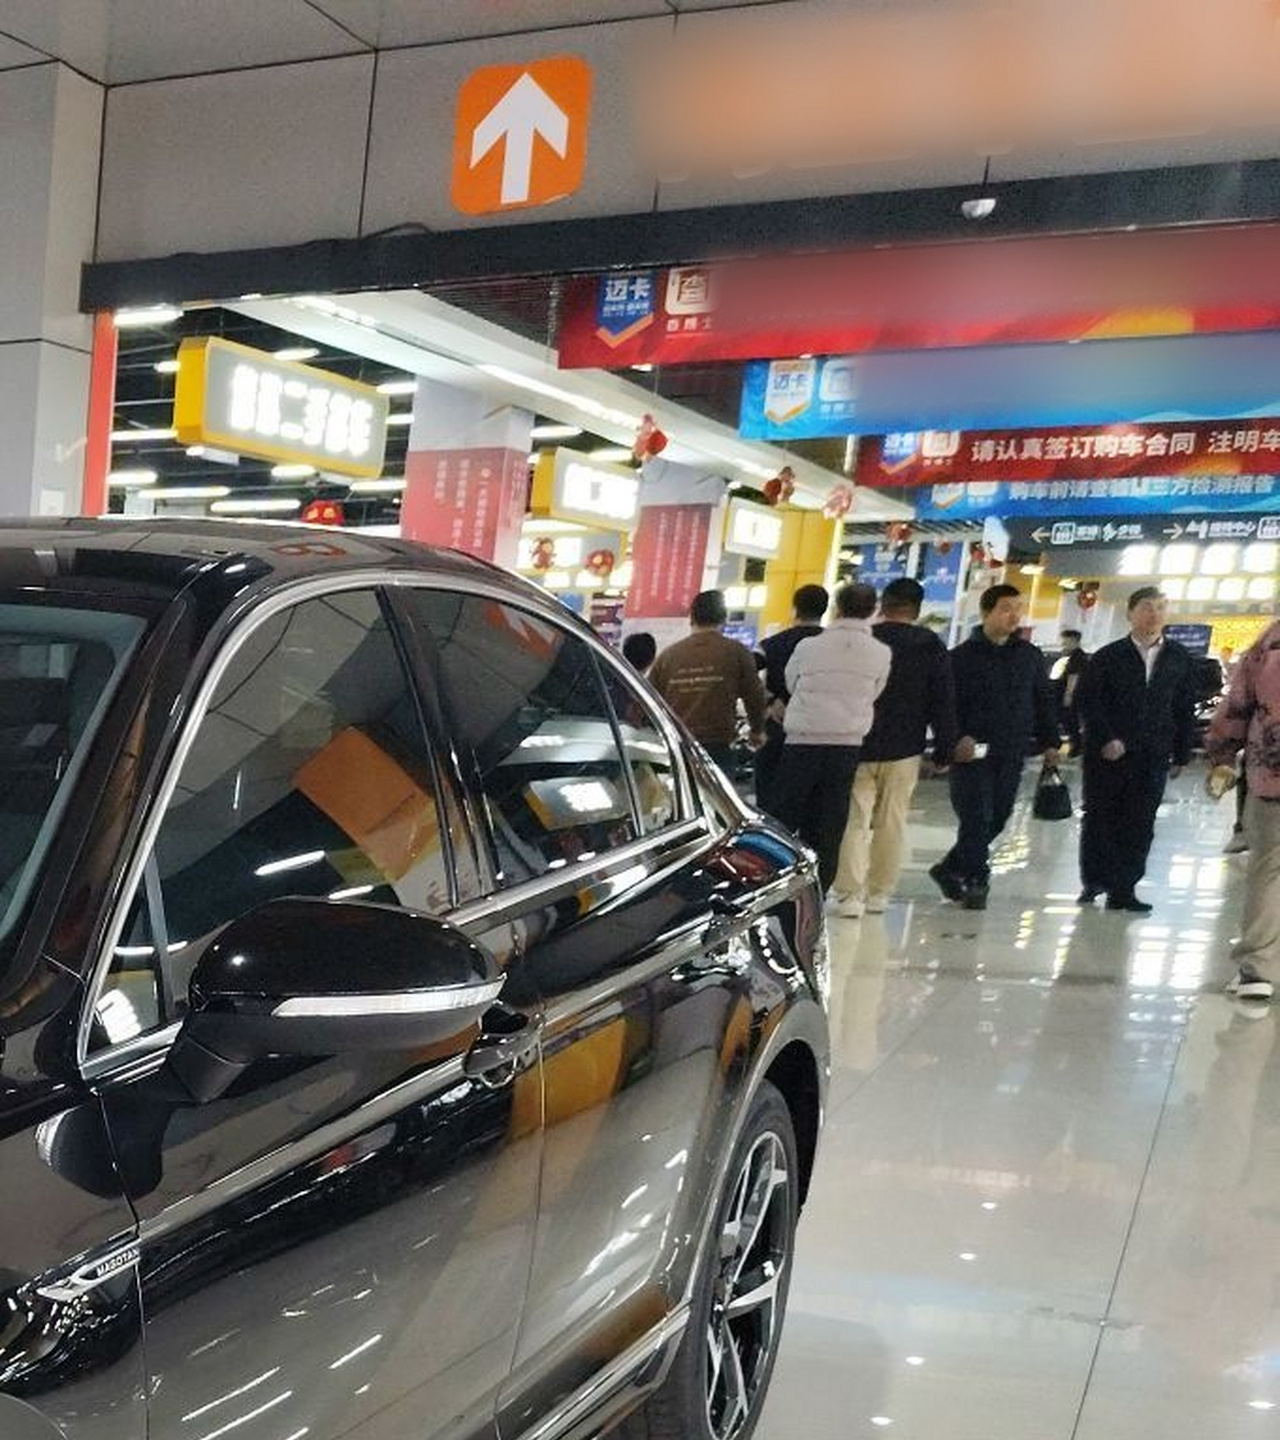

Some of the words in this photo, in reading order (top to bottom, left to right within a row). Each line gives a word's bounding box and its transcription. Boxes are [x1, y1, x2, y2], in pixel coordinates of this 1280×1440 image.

[605, 278, 651, 301] 迈卡
[971, 432, 1197, 462] 请认真签订购车合同
